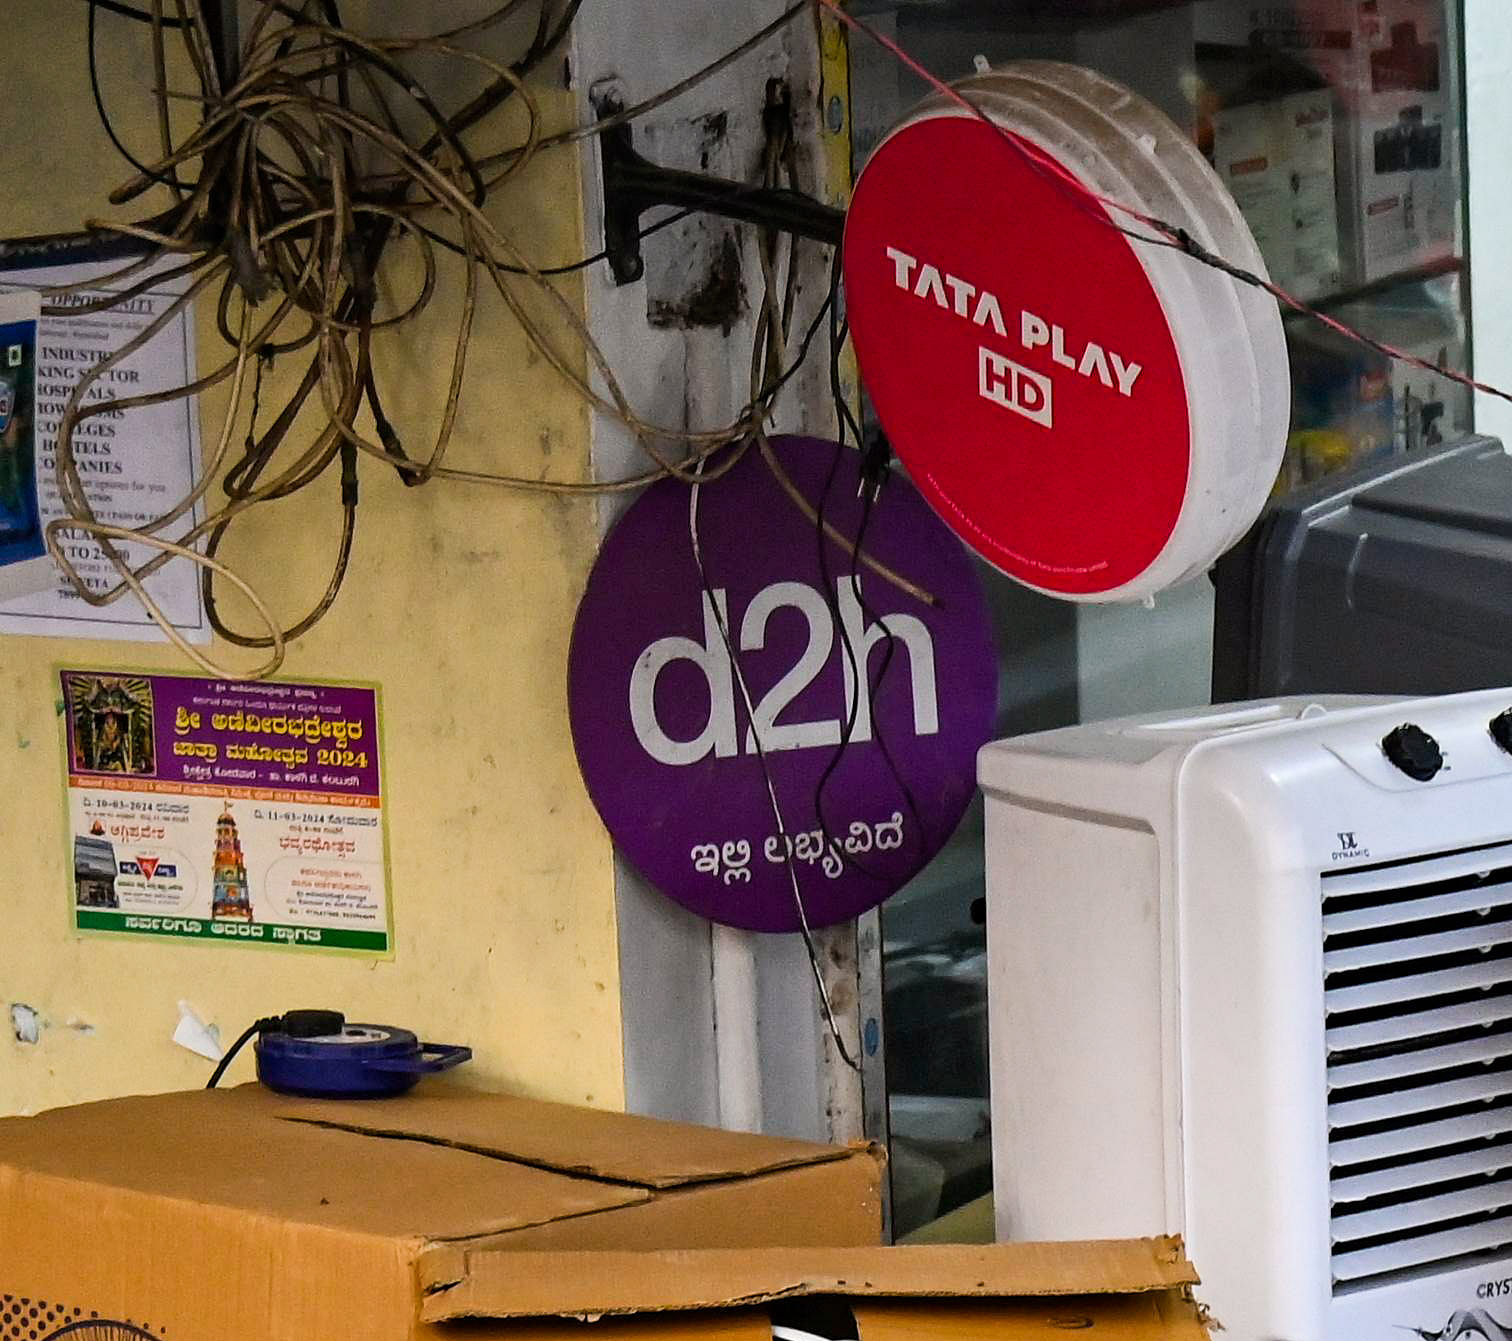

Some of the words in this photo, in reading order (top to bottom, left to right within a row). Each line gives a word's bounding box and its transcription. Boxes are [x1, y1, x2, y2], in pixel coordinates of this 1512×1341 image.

[887, 246, 1007, 337] TATA
[1021, 310, 1142, 397] PLAY
[982, 351, 1049, 420] HD
[629, 574, 939, 766] d2h
[316, 748, 368, 768] 2024
[691, 839, 751, 885] ಇಲ್ಲಿ
[764, 812, 904, 879] ಲಭ್ಯವಿದೆ
